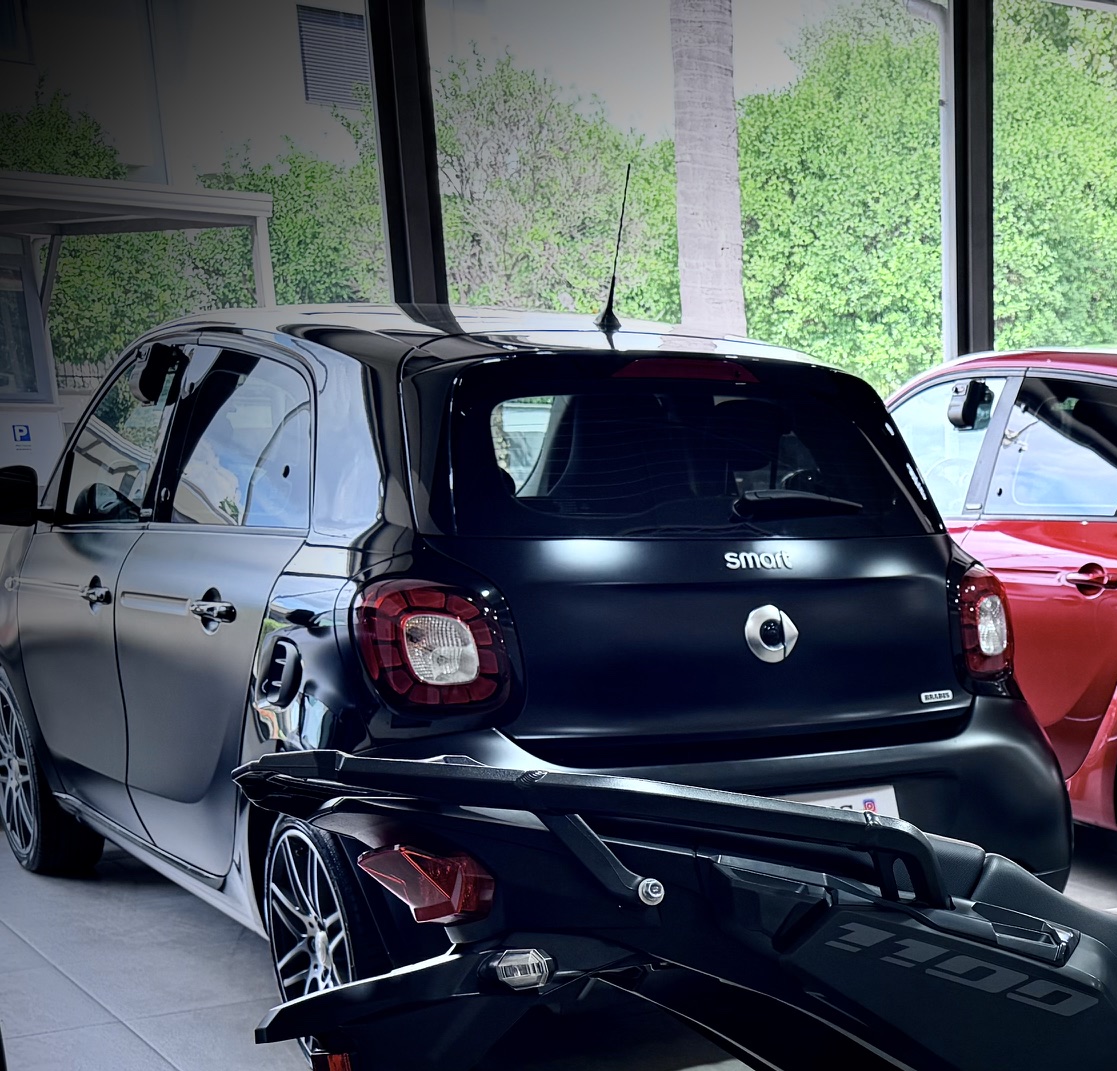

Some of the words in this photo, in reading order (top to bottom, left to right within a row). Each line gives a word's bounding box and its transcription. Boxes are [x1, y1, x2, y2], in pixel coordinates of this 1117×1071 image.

[724, 550, 793, 570] smart
[924, 692, 950, 701] BRABUS
[824, 921, 1100, 1018] 1100
